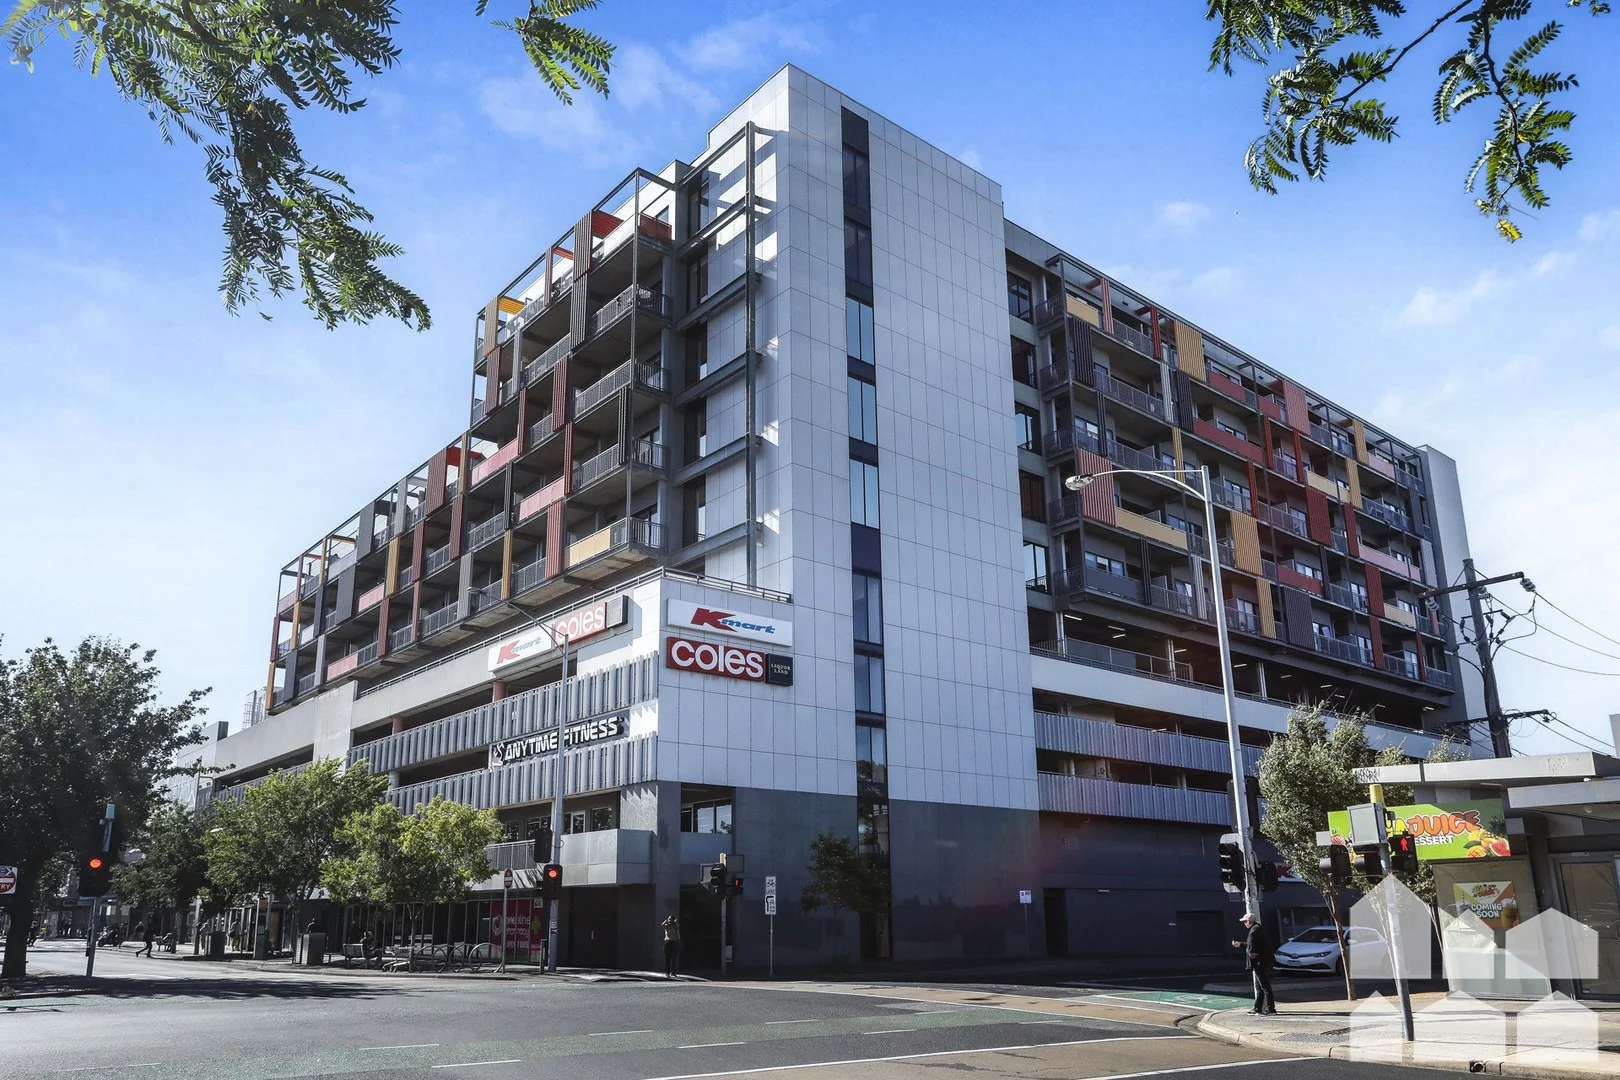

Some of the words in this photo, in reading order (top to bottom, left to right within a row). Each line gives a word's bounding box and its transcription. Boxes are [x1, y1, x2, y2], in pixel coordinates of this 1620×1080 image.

[555, 604, 605, 643] coles
[690, 607, 776, 634] Kmart
[496, 634, 543, 664] Kmart
[671, 640, 764, 679] coles
[770, 663, 792, 671] LIQUOR
[773, 668, 789, 676] LAND
[504, 730, 559, 761] ANYTIME
[563, 716, 619, 747] FITNESS
[1407, 810, 1481, 836] JUICE
[1414, 835, 1455, 847] ESSERT
[1470, 903, 1503, 912] COMING
